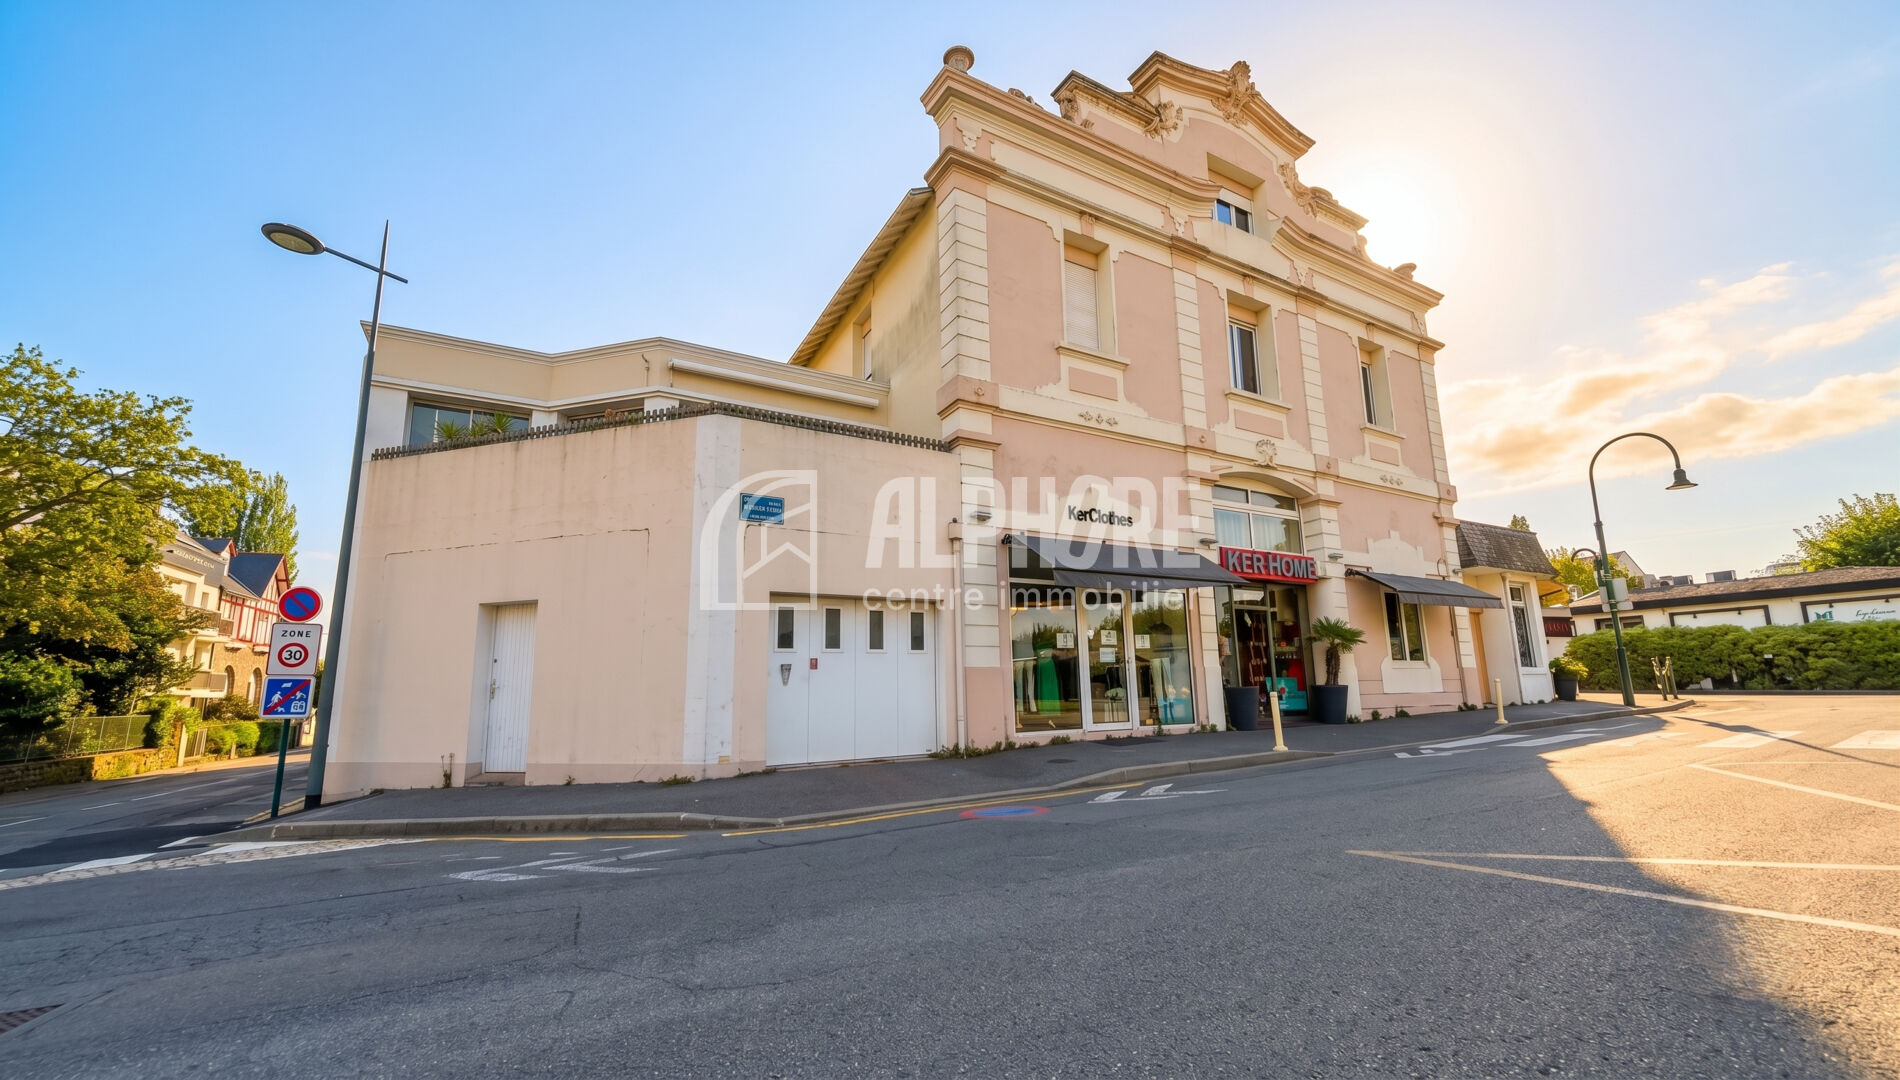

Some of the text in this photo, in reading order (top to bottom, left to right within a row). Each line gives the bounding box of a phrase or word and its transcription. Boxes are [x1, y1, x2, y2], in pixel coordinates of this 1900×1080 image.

[1068, 505, 1134, 527] KerClothes
[1226, 549, 1319, 579] KER HOME
[281, 630, 312, 638] ZONE
[284, 650, 303, 661] 30
